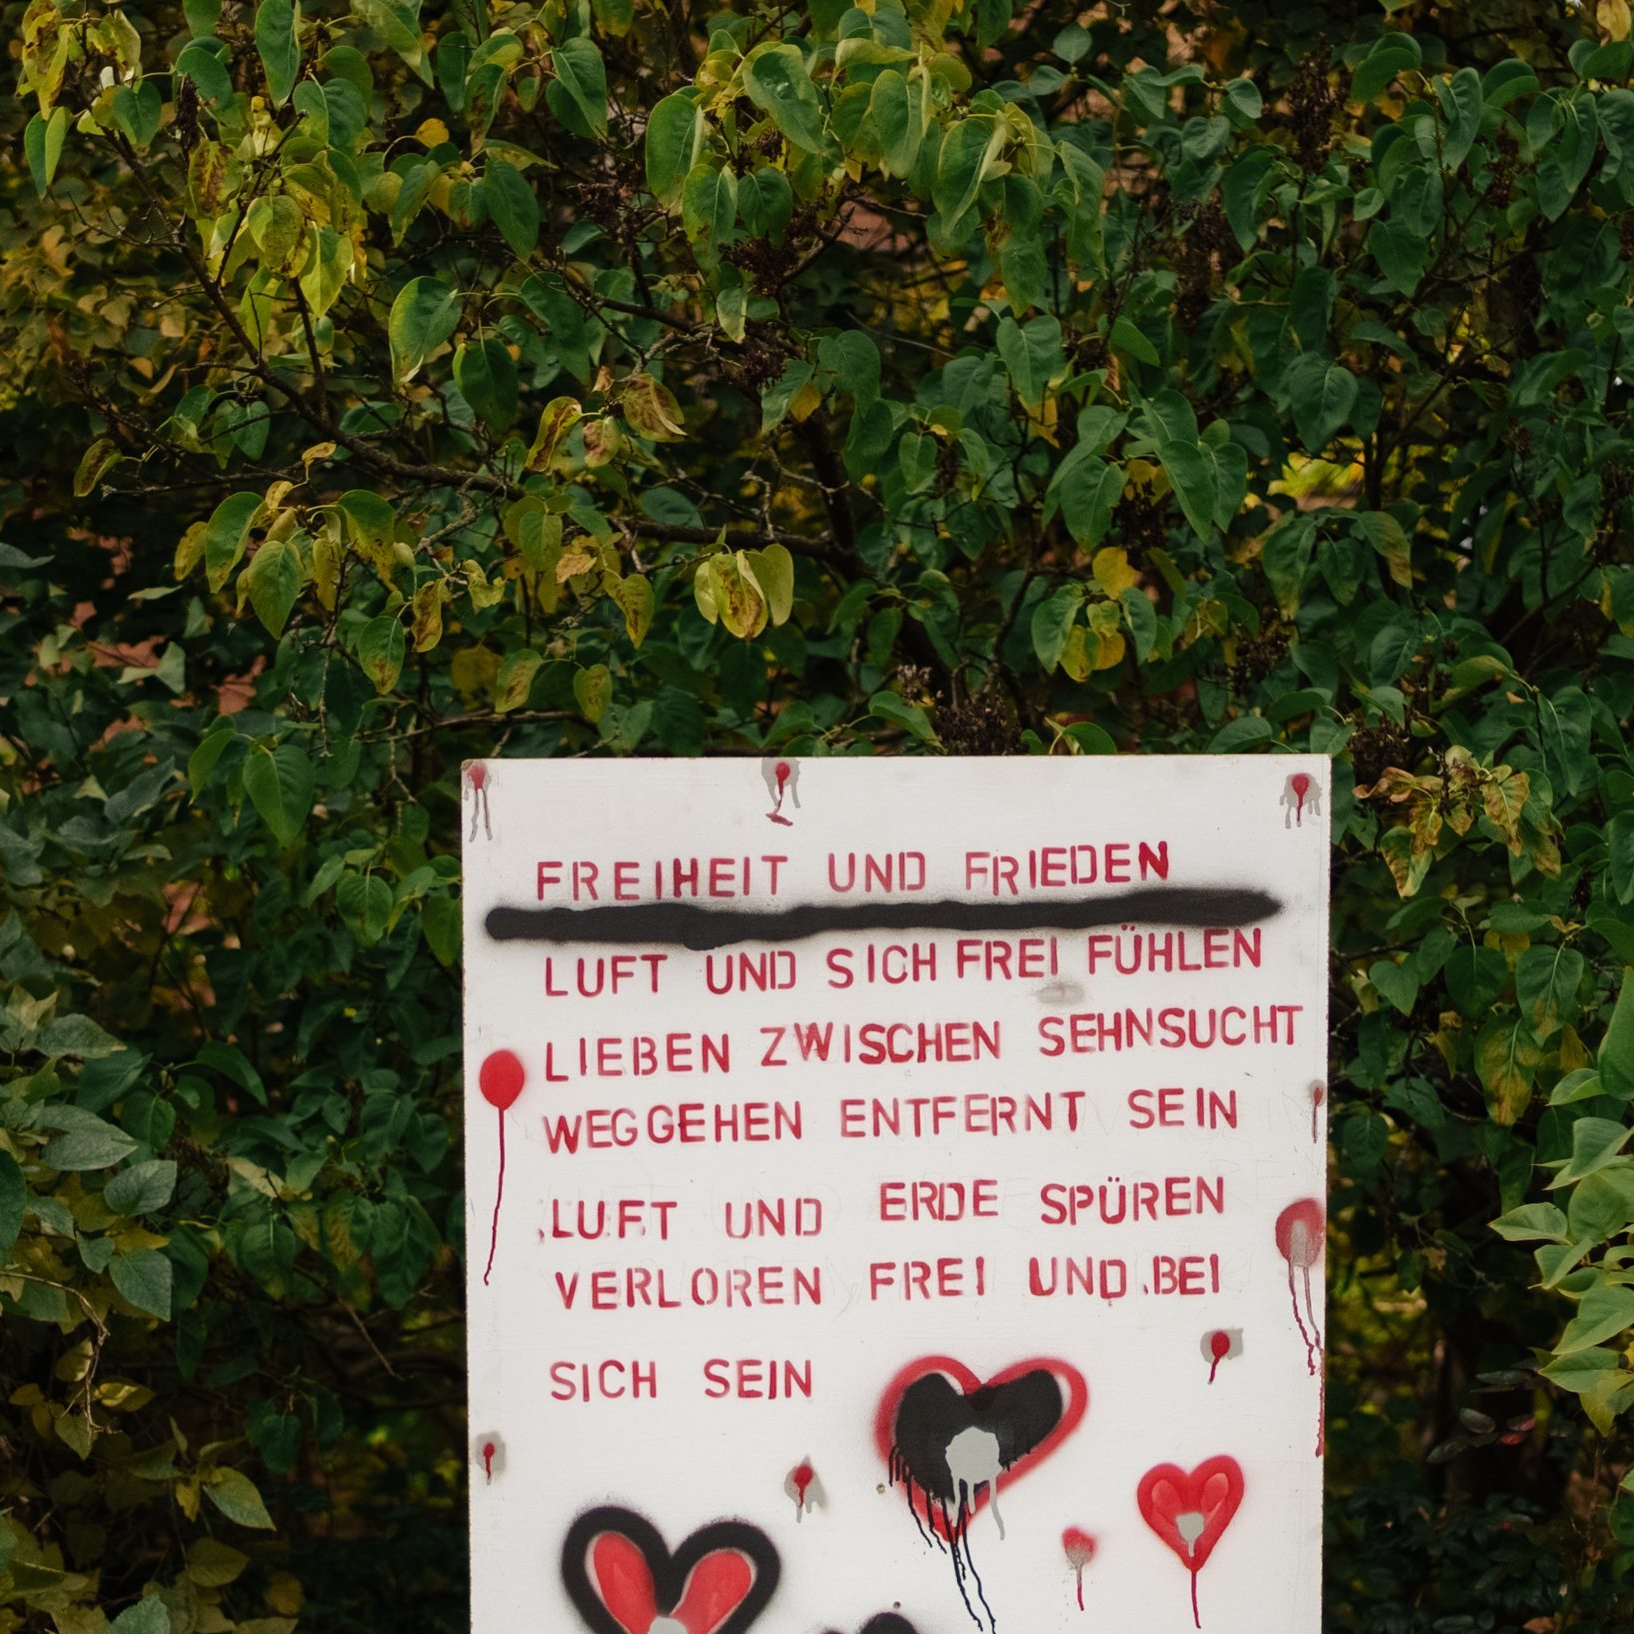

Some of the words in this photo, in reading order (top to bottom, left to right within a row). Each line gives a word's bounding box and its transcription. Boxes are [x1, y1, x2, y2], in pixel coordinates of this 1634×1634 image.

[536, 854, 789, 902] FREIHEIT
[827, 850, 927, 893] UND
[964, 839, 1171, 889] FRIEDEN
[544, 953, 669, 999] LUFT
[705, 949, 797, 997] UND
[825, 943, 937, 989] SICH
[956, 937, 1059, 982] FREI
[1086, 923, 1263, 976] FÜHLEN
[544, 1031, 731, 1084] LIEBEN
[760, 1019, 1002, 1068] ZWISCHEN
[1038, 1003, 1304, 1057] SEHNSUCHT
[542, 1100, 803, 1156] WEGGEHEN
[839, 1090, 1087, 1139] ENTFERNT
[1127, 1087, 1238, 1131] SEIN
[551, 1199, 679, 1241] LUFT
[724, 1197, 823, 1239] UND
[878, 1178, 999, 1223] ERDE
[1039, 1175, 1225, 1226] SPÜREN
[554, 1266, 823, 1312] VERLOREN
[869, 1255, 986, 1301] FREI
[1028, 1256, 1128, 1301] UND
[1152, 1252, 1221, 1297] BEI
[549, 1359, 658, 1402] SICH
[703, 1358, 813, 1401] SEIN
